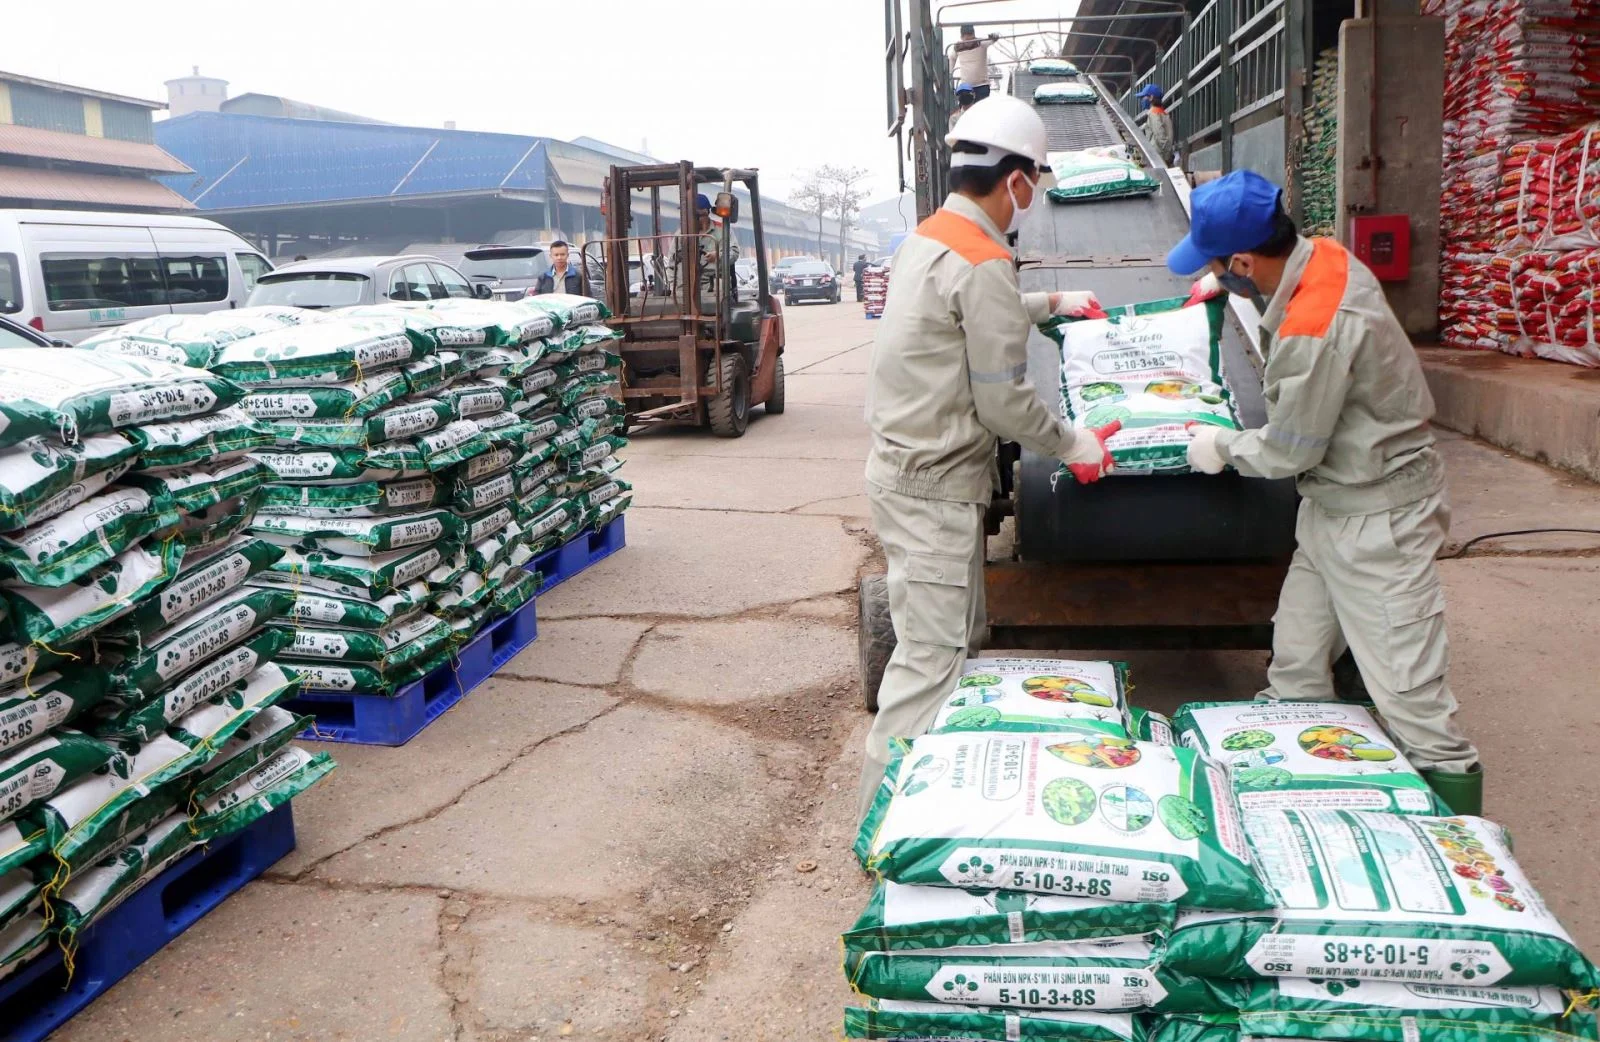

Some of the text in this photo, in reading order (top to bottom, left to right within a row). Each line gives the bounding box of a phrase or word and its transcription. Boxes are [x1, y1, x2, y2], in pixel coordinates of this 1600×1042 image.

[1114, 358, 1165, 371] 5-10-3+8S
[238, 397, 283, 409] 5-10-3+8S
[117, 412, 132, 422] ISO
[190, 576, 226, 607] 5-10-3+8S
[236, 609, 248, 620] ISO
[189, 629, 229, 662] 5-10-3+8S
[237, 651, 250, 662] ISO
[46, 697, 62, 710] ISO
[1077, 860, 1094, 873] SINH
[1112, 863, 1130, 876] THAO
[1142, 870, 1170, 883] ISO
[1013, 871, 1112, 897] 5-10-3+8S
[1324, 942, 1428, 965] 5-10-3+8S
[1264, 962, 1292, 972] ISO
[1306, 966, 1324, 976] THAO
[1342, 968, 1359, 978] SINH
[984, 972, 1002, 984] PHÂN
[1053, 973, 1060, 984] VI
[1061, 973, 1077, 984] SINH
[1078, 972, 1092, 984] LÂM
[1094, 973, 1110, 984] THAO
[1123, 976, 1149, 988] ISO
[999, 988, 1096, 1006] 5-10-3+8S
